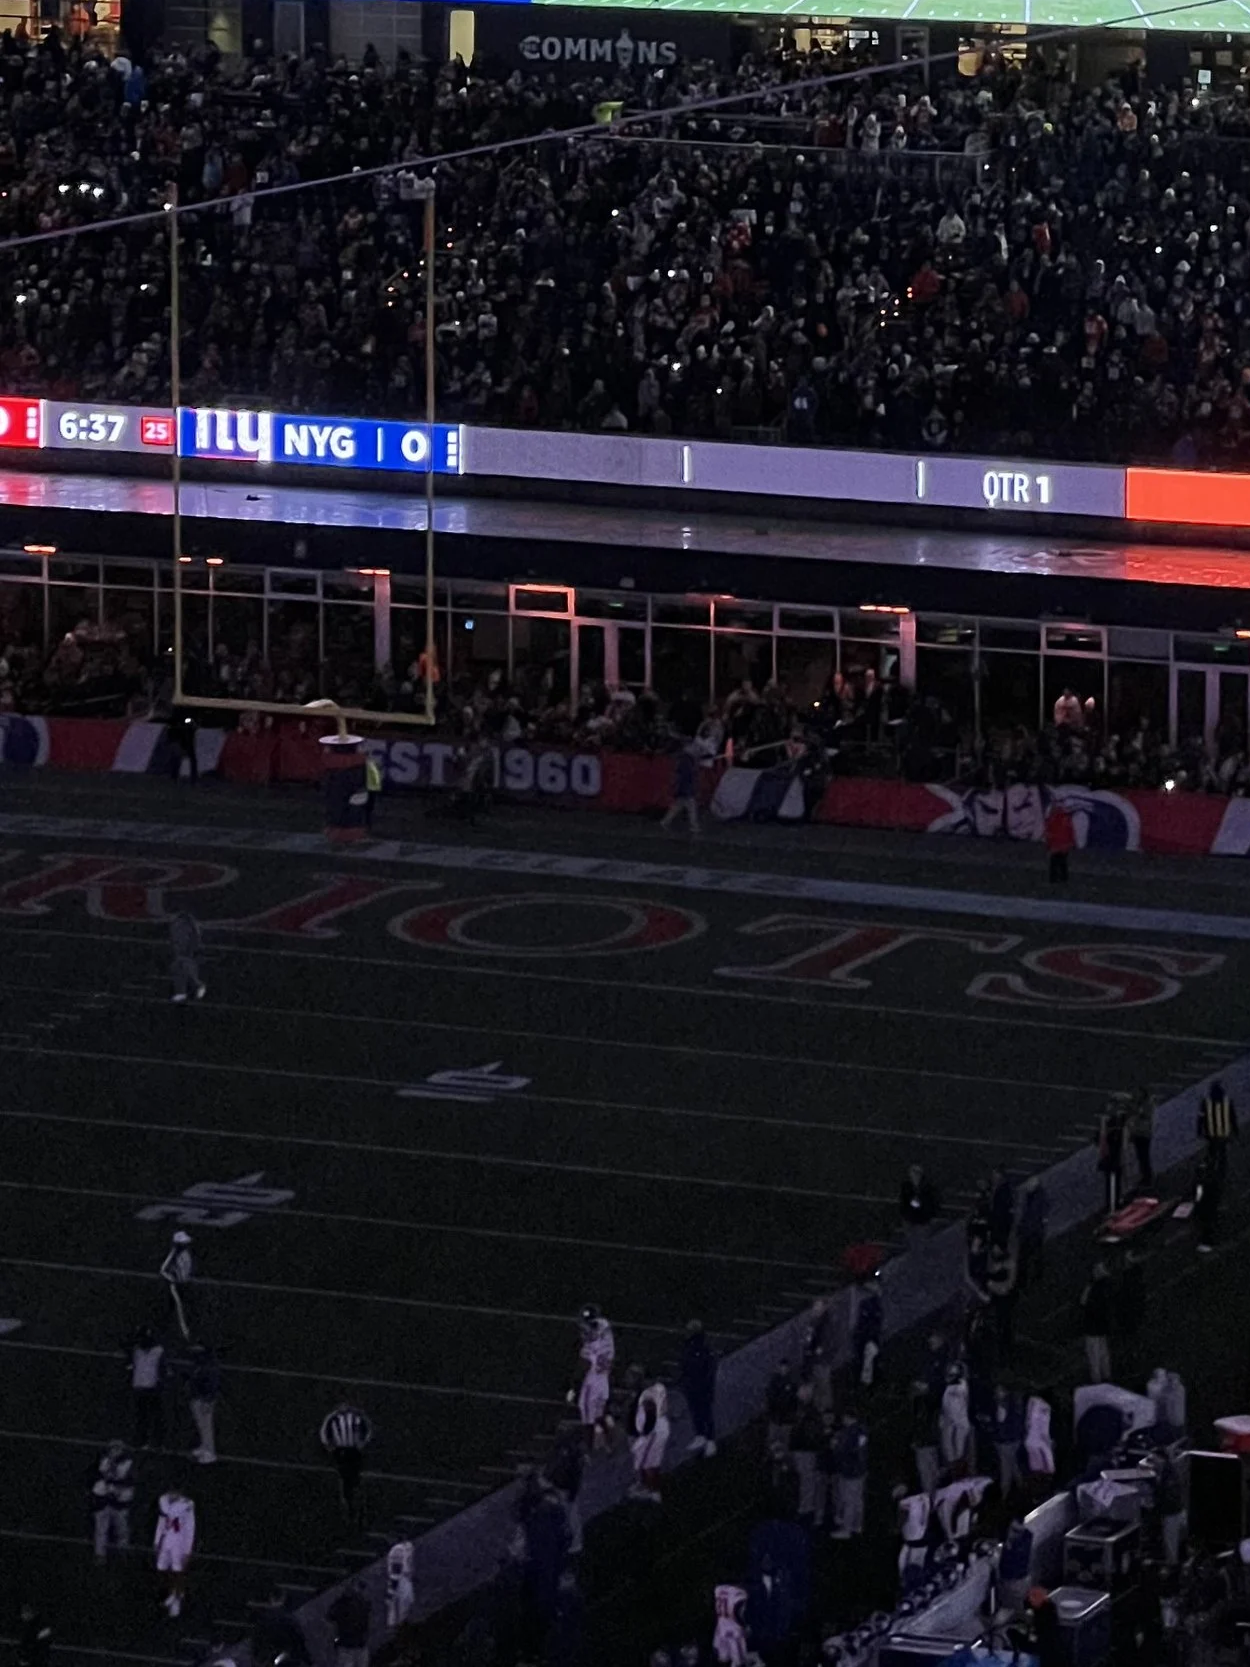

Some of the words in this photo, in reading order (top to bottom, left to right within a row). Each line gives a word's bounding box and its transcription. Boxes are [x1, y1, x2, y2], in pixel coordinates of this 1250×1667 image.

[60, 412, 125, 442] 6:37
[145, 423, 167, 440] 25
[284, 425, 355, 459] NYG
[401, 430, 426, 461] 0
[983, 471, 1030, 507] QTR
[1036, 476, 1049, 504] 1
[0, 849, 1227, 1009] RIOTS
